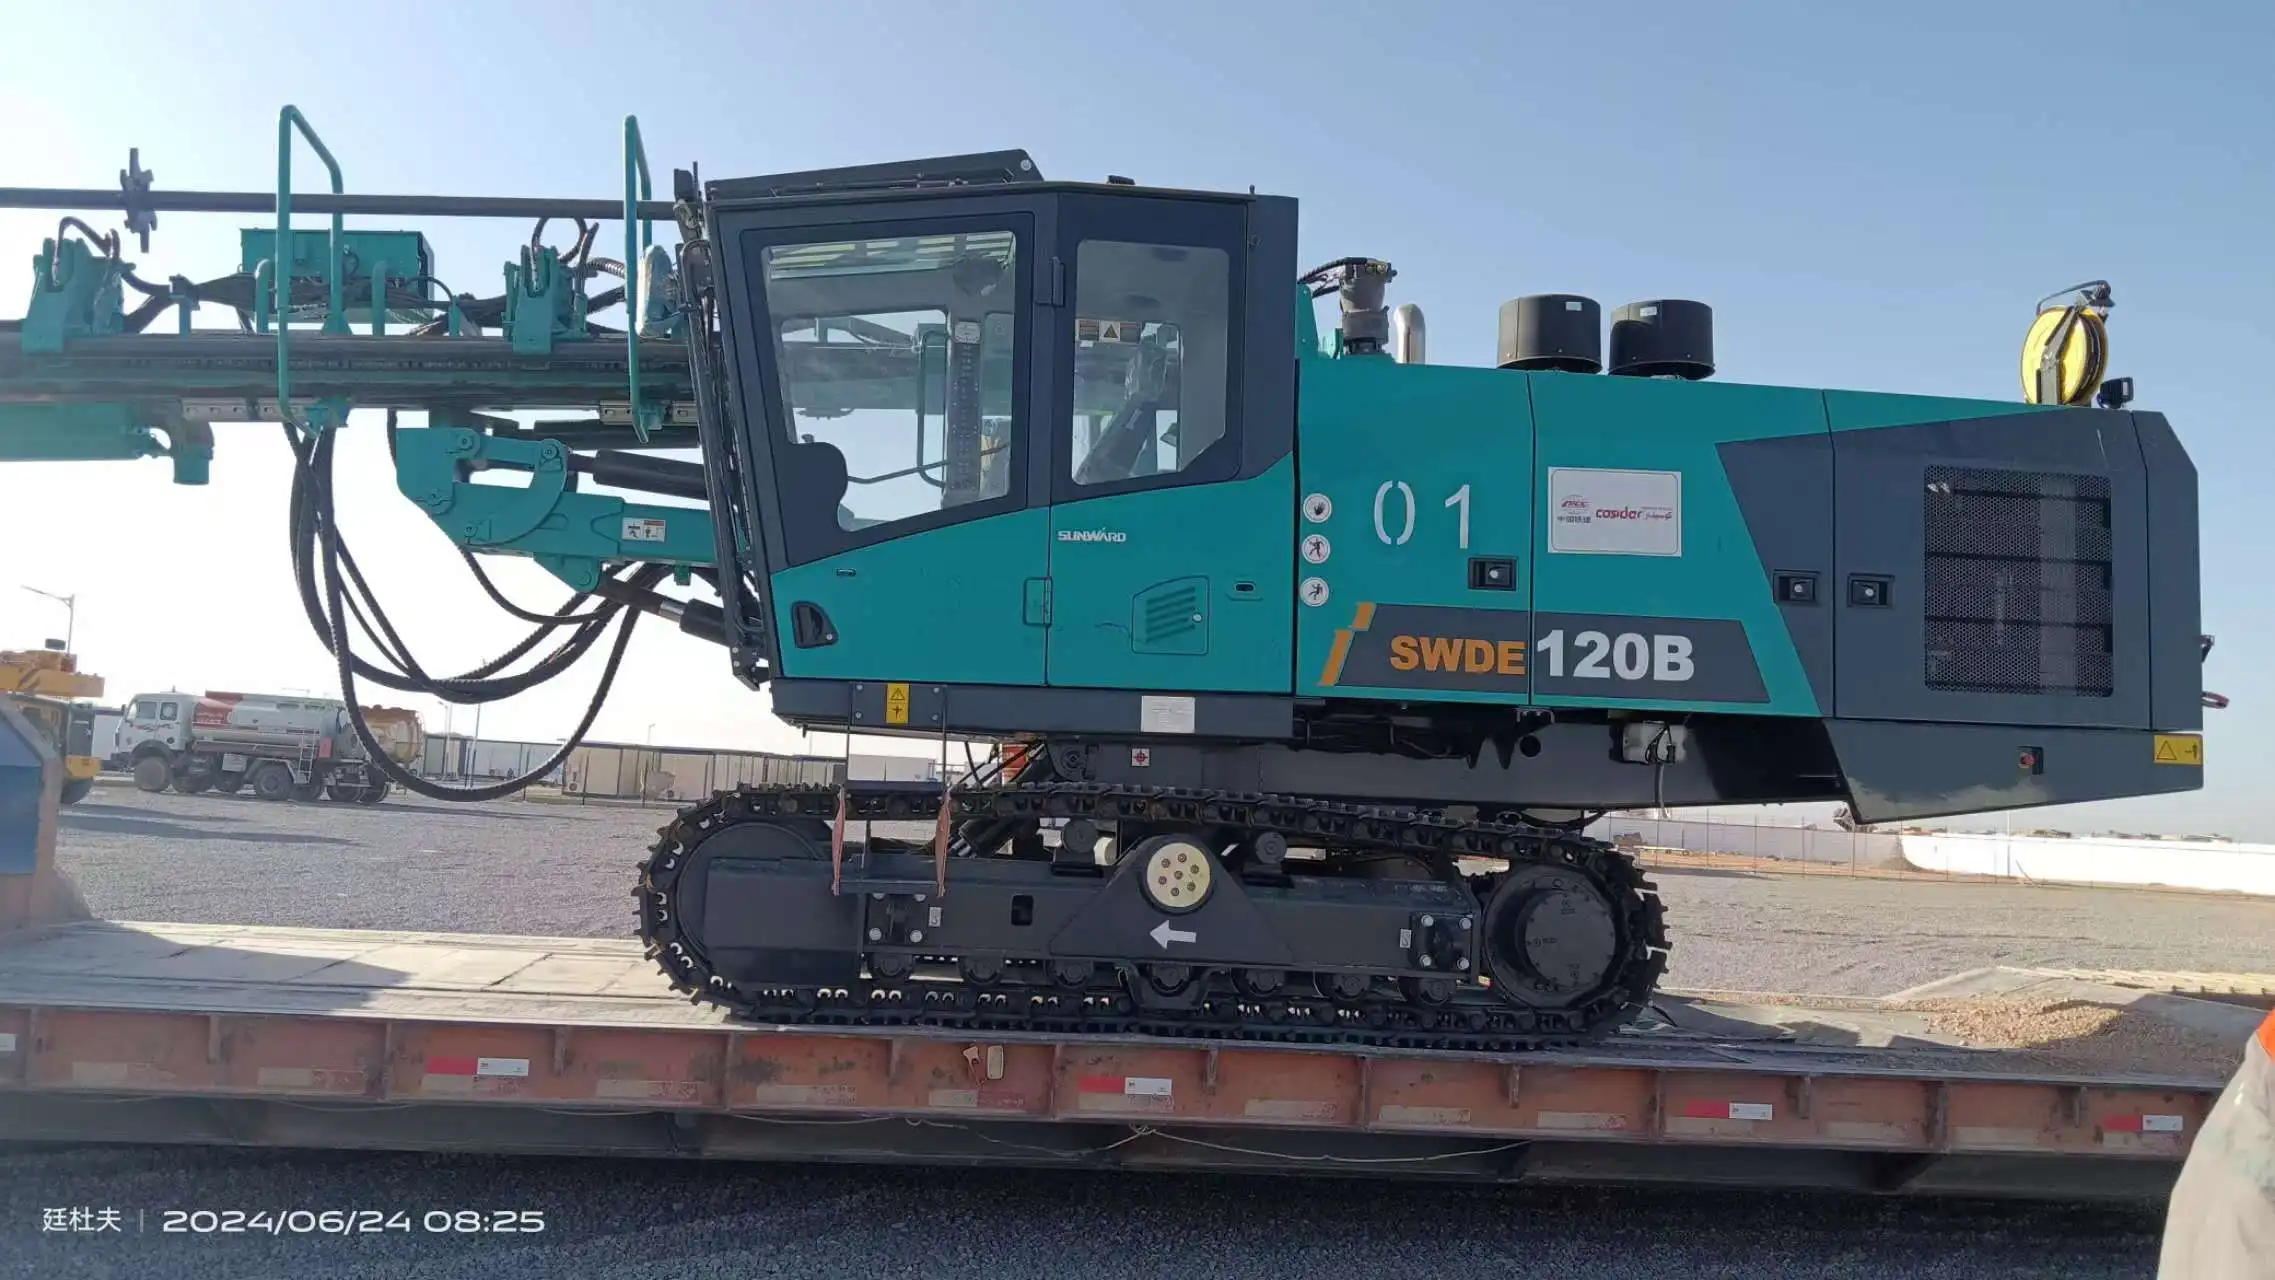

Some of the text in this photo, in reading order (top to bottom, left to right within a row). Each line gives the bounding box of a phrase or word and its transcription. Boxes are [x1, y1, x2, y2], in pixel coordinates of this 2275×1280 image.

[1057, 528, 1127, 542] SUNWARD
[1390, 630, 1694, 681] SWDE 120B
